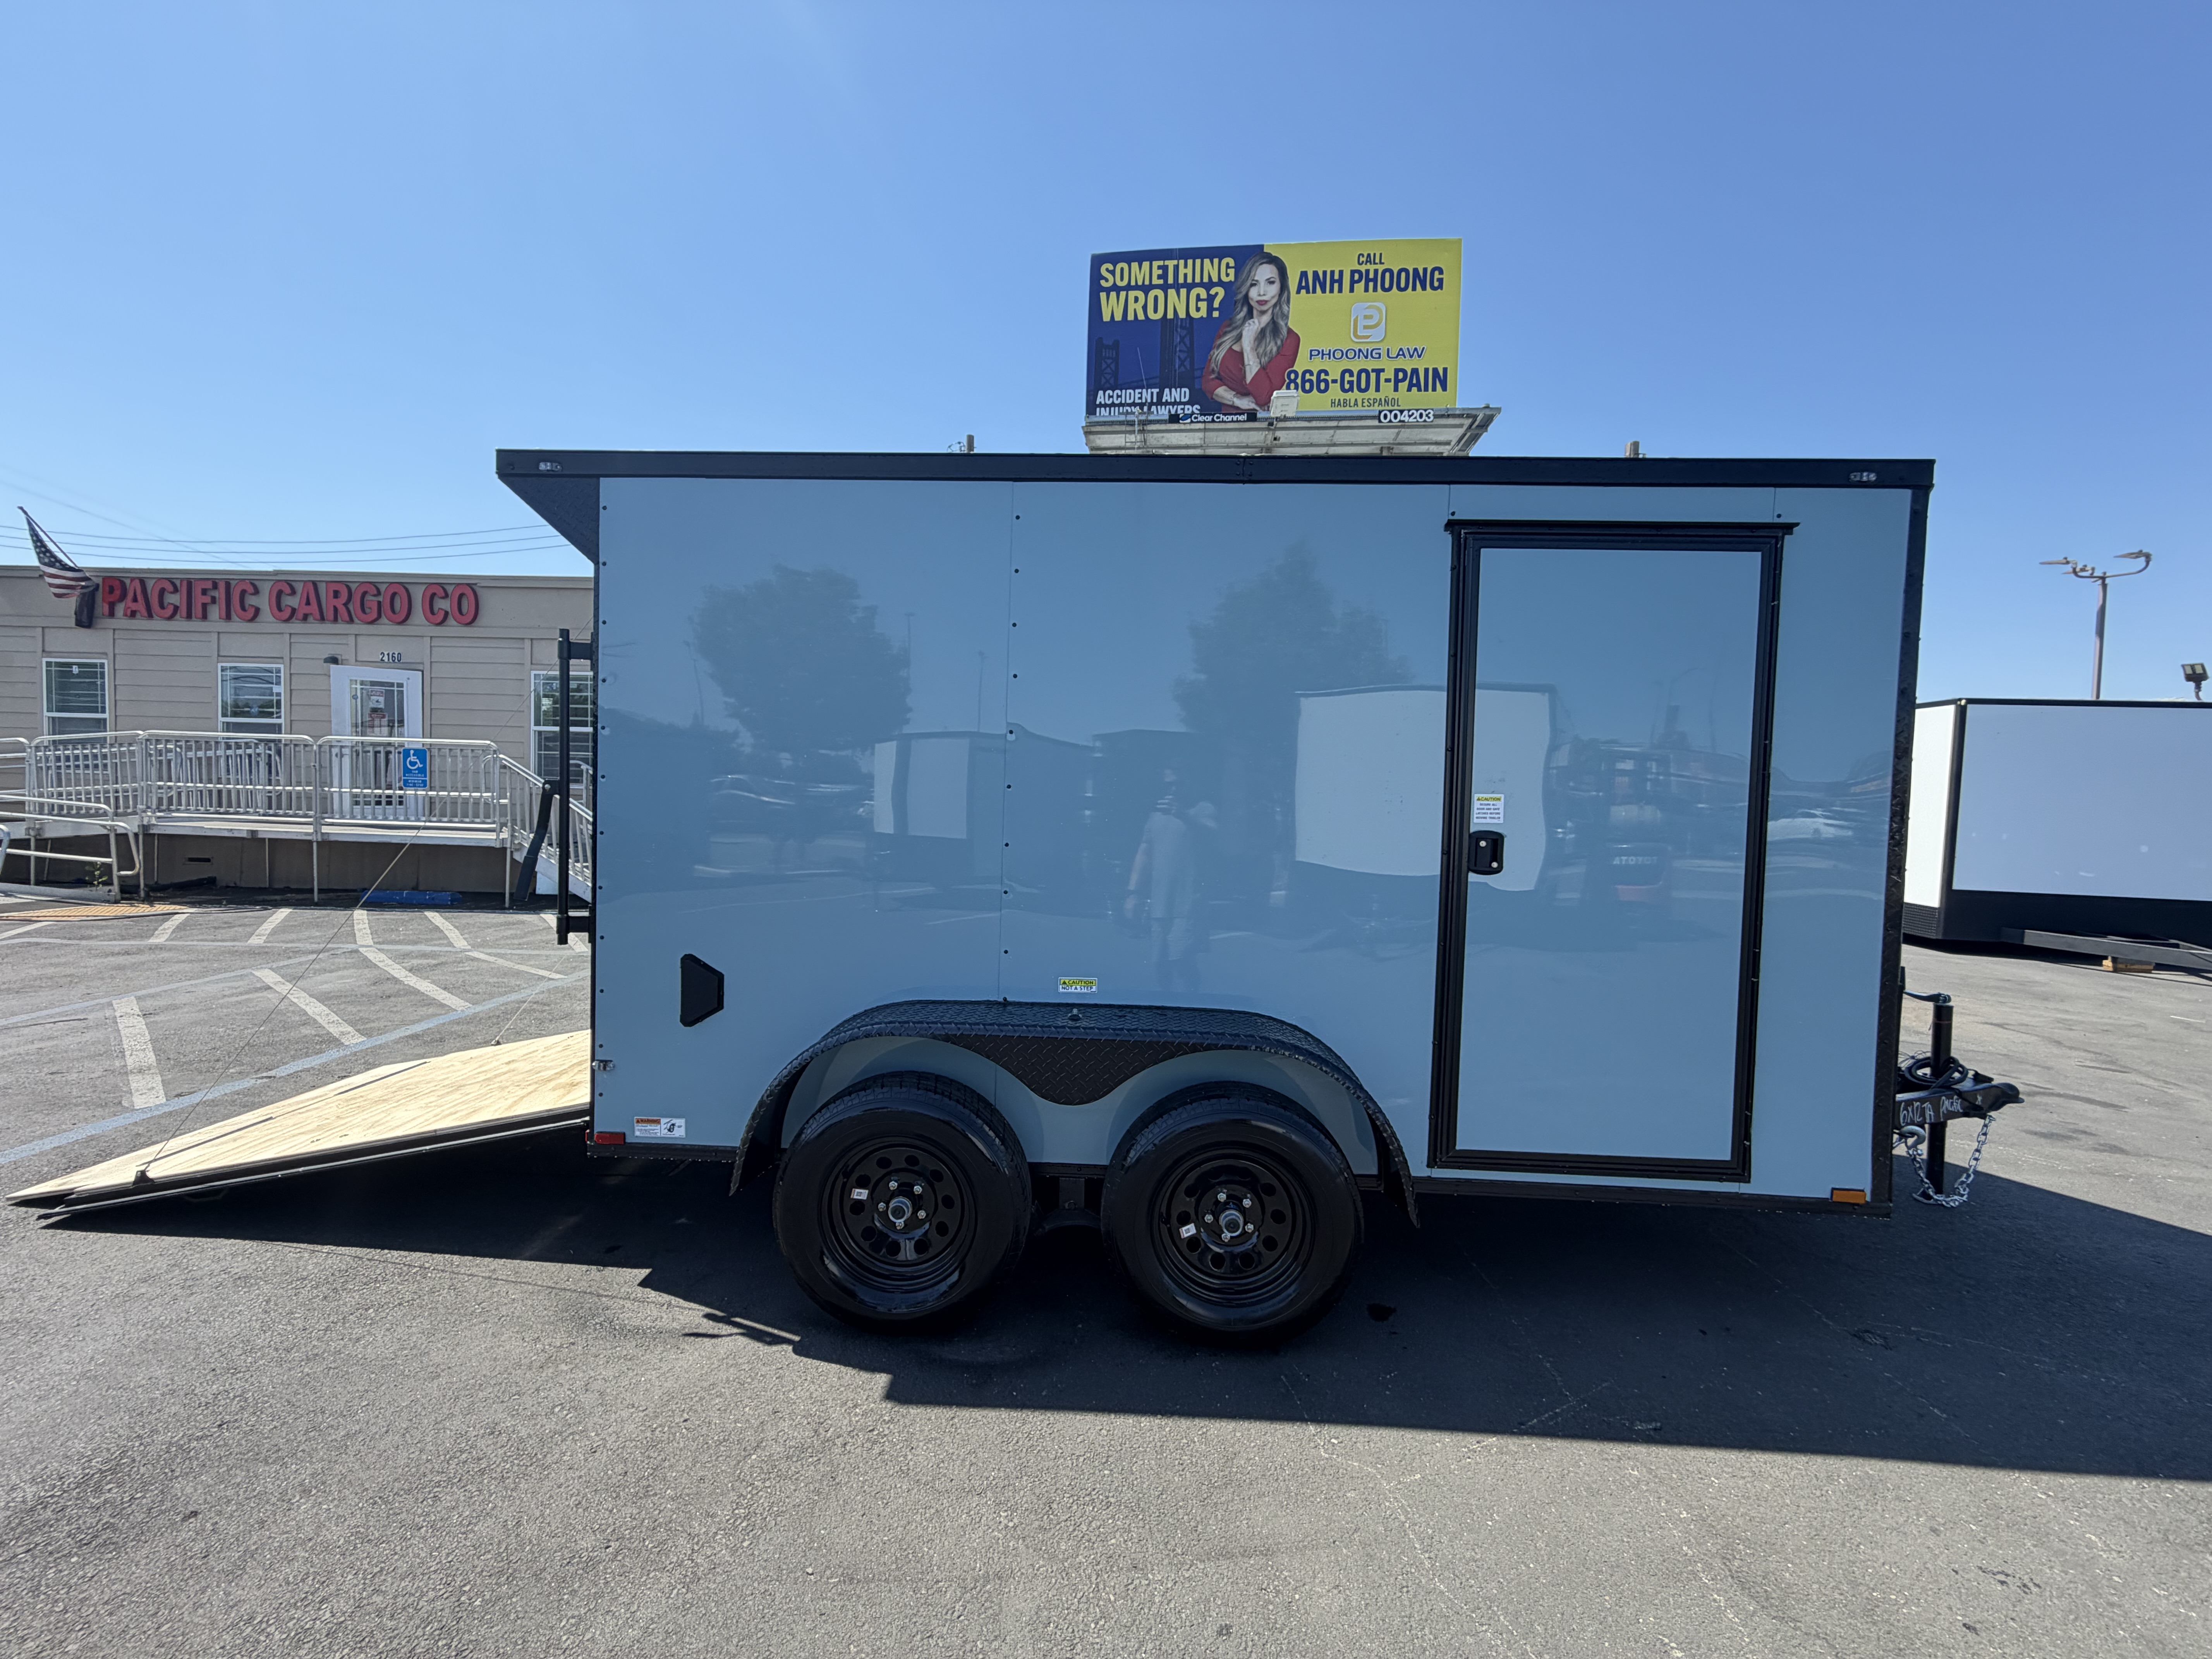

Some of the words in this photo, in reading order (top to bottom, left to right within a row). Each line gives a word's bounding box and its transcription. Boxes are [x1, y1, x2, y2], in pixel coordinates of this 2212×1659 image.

[1357, 252, 1384, 266] CALL
[1100, 257, 1235, 287] SOMETHING
[1296, 270, 1344, 295] ANH
[1349, 266, 1444, 293] PHOONG
[1100, 287, 1225, 321] WRONG?
[1309, 347, 1382, 361] PHOONG
[1386, 347, 1425, 360] LAW
[1286, 367, 1448, 394] 866-GOT-PAIN
[1096, 388, 1159, 404] ACCIDENT
[1162, 388, 1189, 402] AND
[1331, 398, 1358, 408] HABLA
[1361, 396, 1401, 407] ESPAÑOL
[1214, 413, 1247, 421] Channel
[1380, 409, 1434, 422] 004203
[102, 577, 260, 621] PACIFIC
[268, 580, 412, 623] CARGO
[422, 583, 479, 625] CO
[380, 652, 402, 662] 2160
